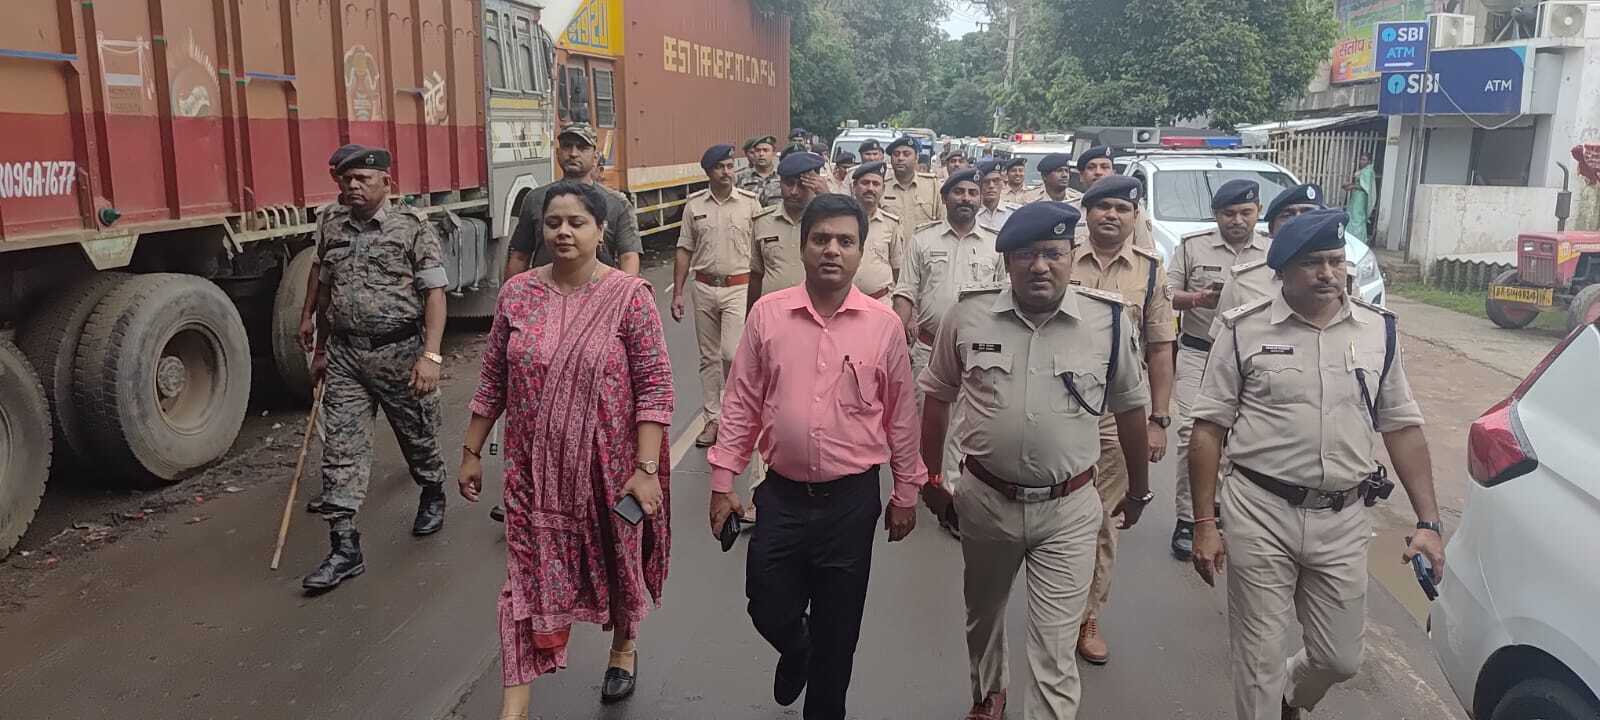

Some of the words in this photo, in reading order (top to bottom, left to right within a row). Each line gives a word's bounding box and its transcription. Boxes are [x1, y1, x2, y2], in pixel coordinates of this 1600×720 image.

[1397, 27, 1424, 41] SBI
[664, 35, 691, 74] BEST
[1385, 46, 1416, 58] ATM
[1407, 73, 1440, 93] SBI
[1484, 78, 1513, 92] ATM
